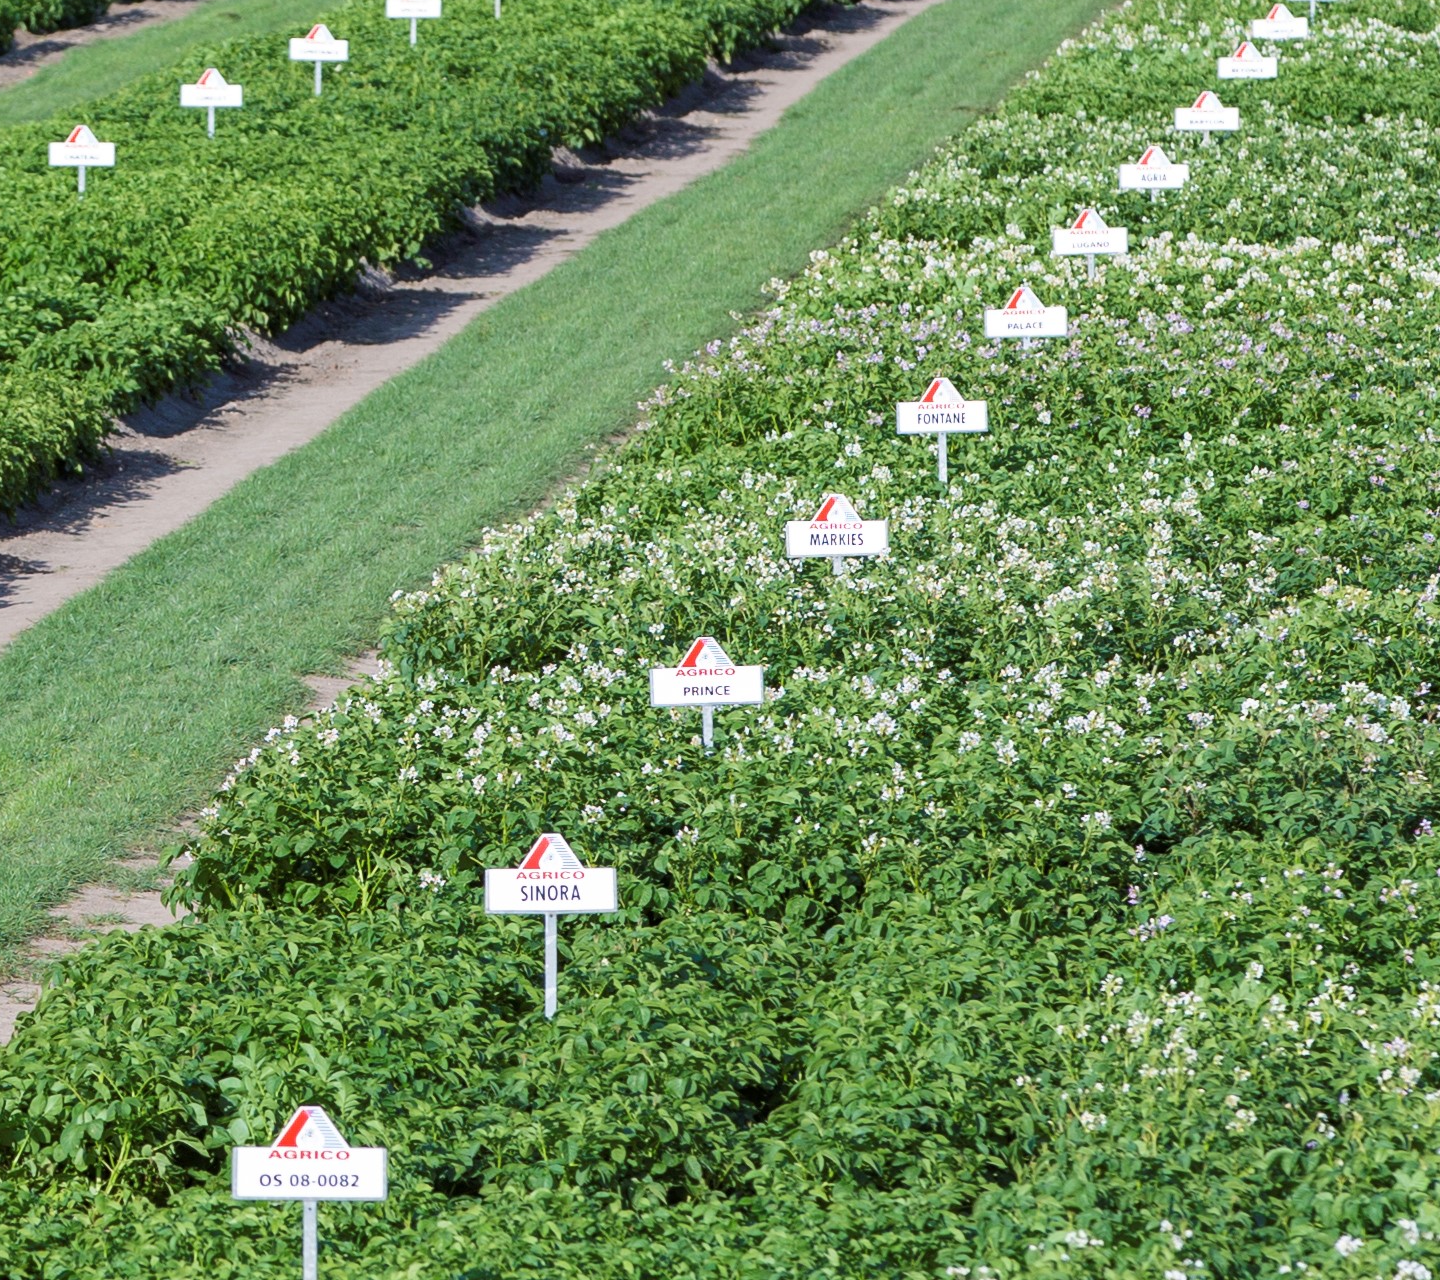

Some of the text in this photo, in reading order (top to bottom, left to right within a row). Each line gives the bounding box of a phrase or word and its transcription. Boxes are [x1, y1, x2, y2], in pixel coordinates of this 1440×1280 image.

[1141, 173, 1168, 182] AGRIA
[1072, 241, 1110, 249] LUGANO
[1007, 321, 1043, 330] PALACE
[918, 402, 965, 410] AGRICO
[918, 412, 966, 425] FONTANE
[810, 522, 864, 530] AGRICO
[810, 533, 864, 547] MARKIES
[676, 668, 736, 677] AGRICO
[684, 686, 731, 697] PRINCE
[516, 871, 584, 879] AGRICO
[521, 886, 580, 901] SINORA
[268, 1149, 351, 1160] AGRICO
[260, 1174, 360, 1187] OS 08-0082
